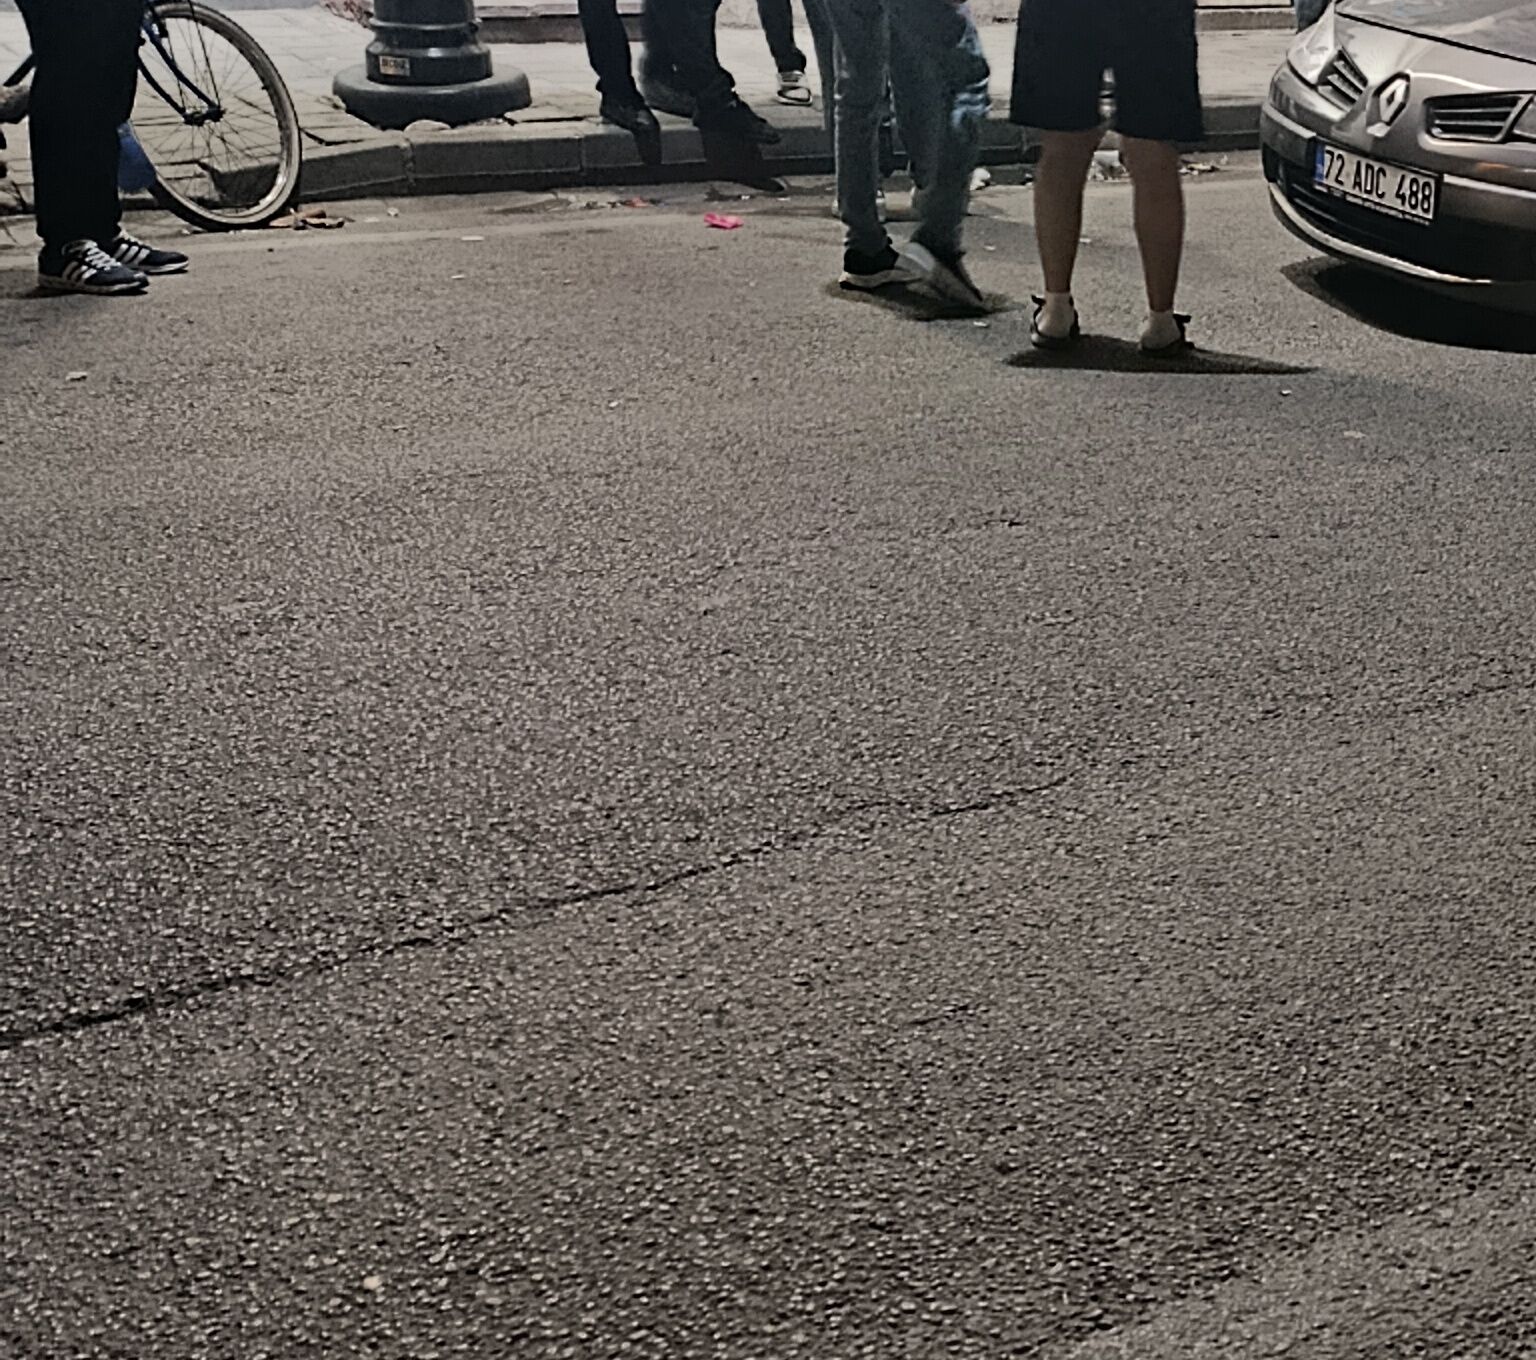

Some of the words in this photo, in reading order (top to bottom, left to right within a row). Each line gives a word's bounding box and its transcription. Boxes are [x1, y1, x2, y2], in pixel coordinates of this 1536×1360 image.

[1325, 150, 1345, 186] 72
[1353, 160, 1387, 199] ADC
[1395, 174, 1433, 214] 488
